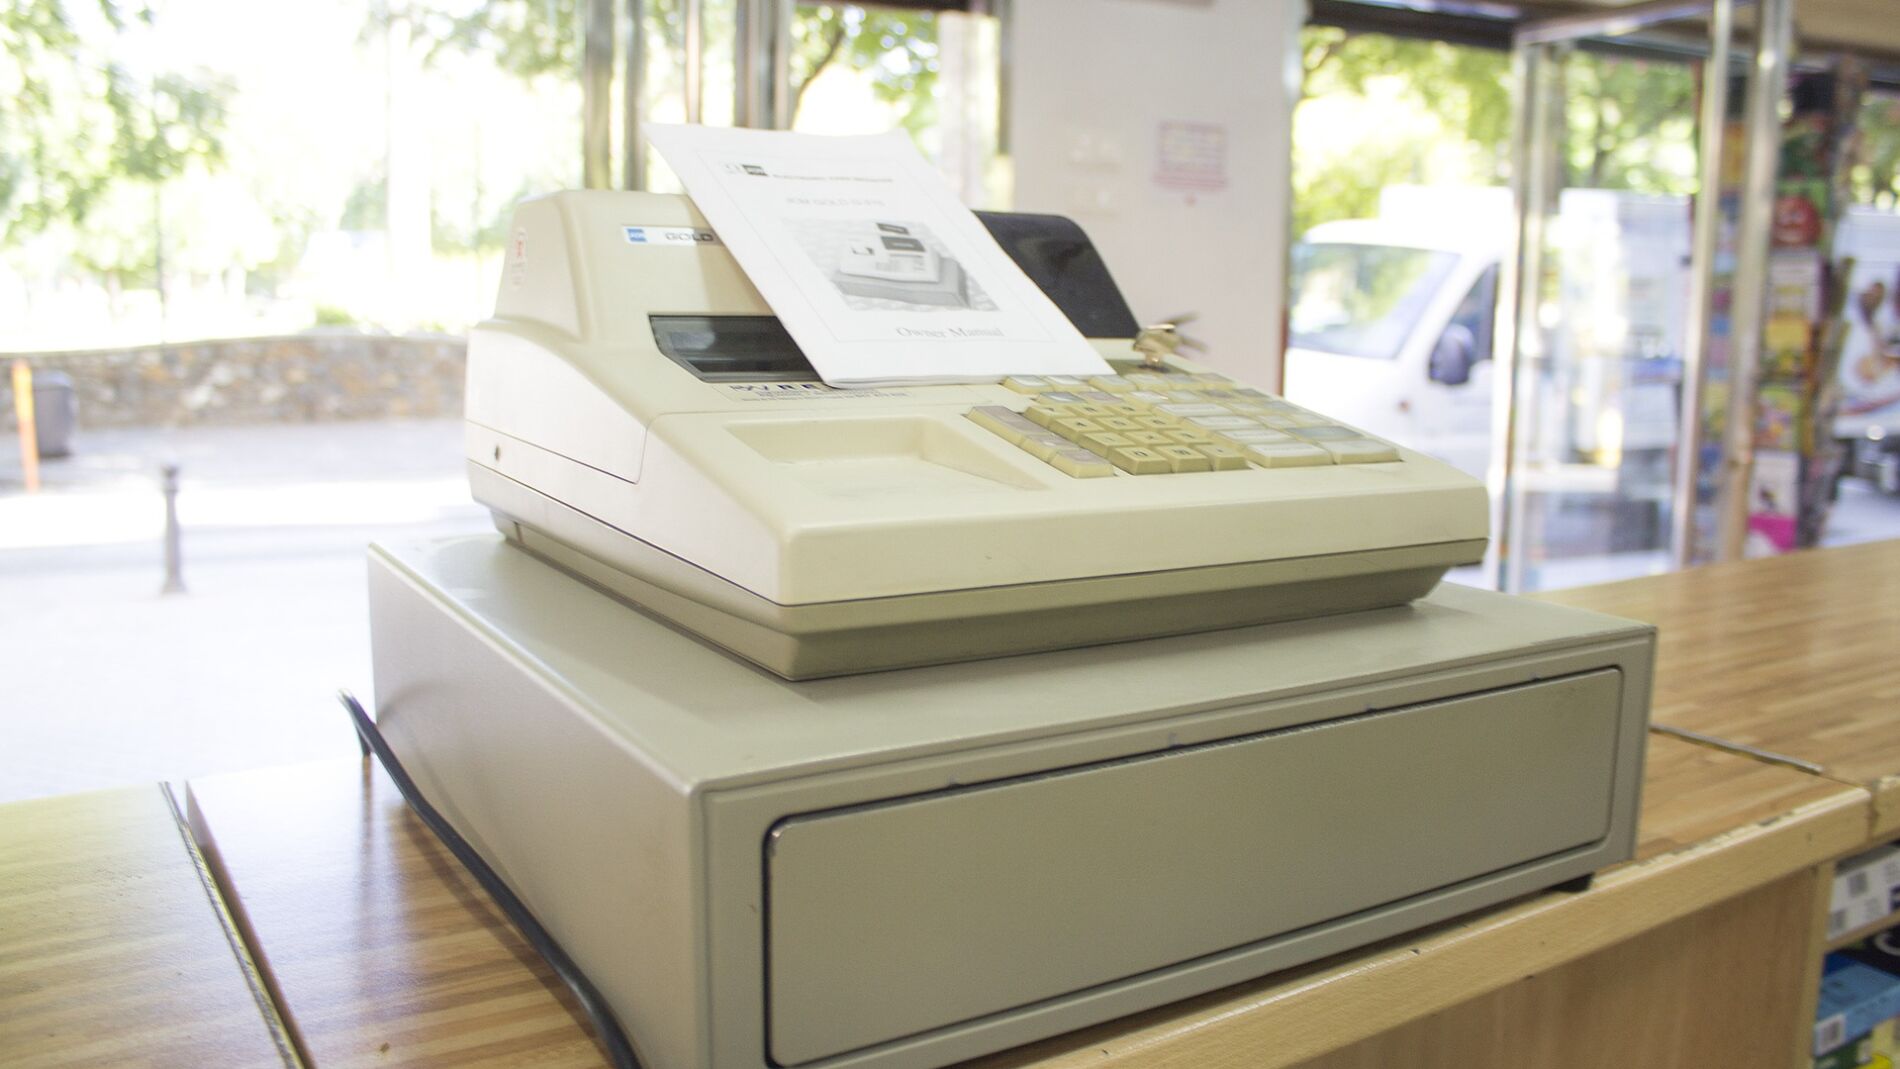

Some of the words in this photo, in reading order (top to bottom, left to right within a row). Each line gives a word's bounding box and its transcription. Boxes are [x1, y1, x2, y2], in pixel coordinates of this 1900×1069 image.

[664, 232, 714, 242] GOLD
[895, 326, 946, 338] Owner
[948, 326, 1006, 338] Manual
